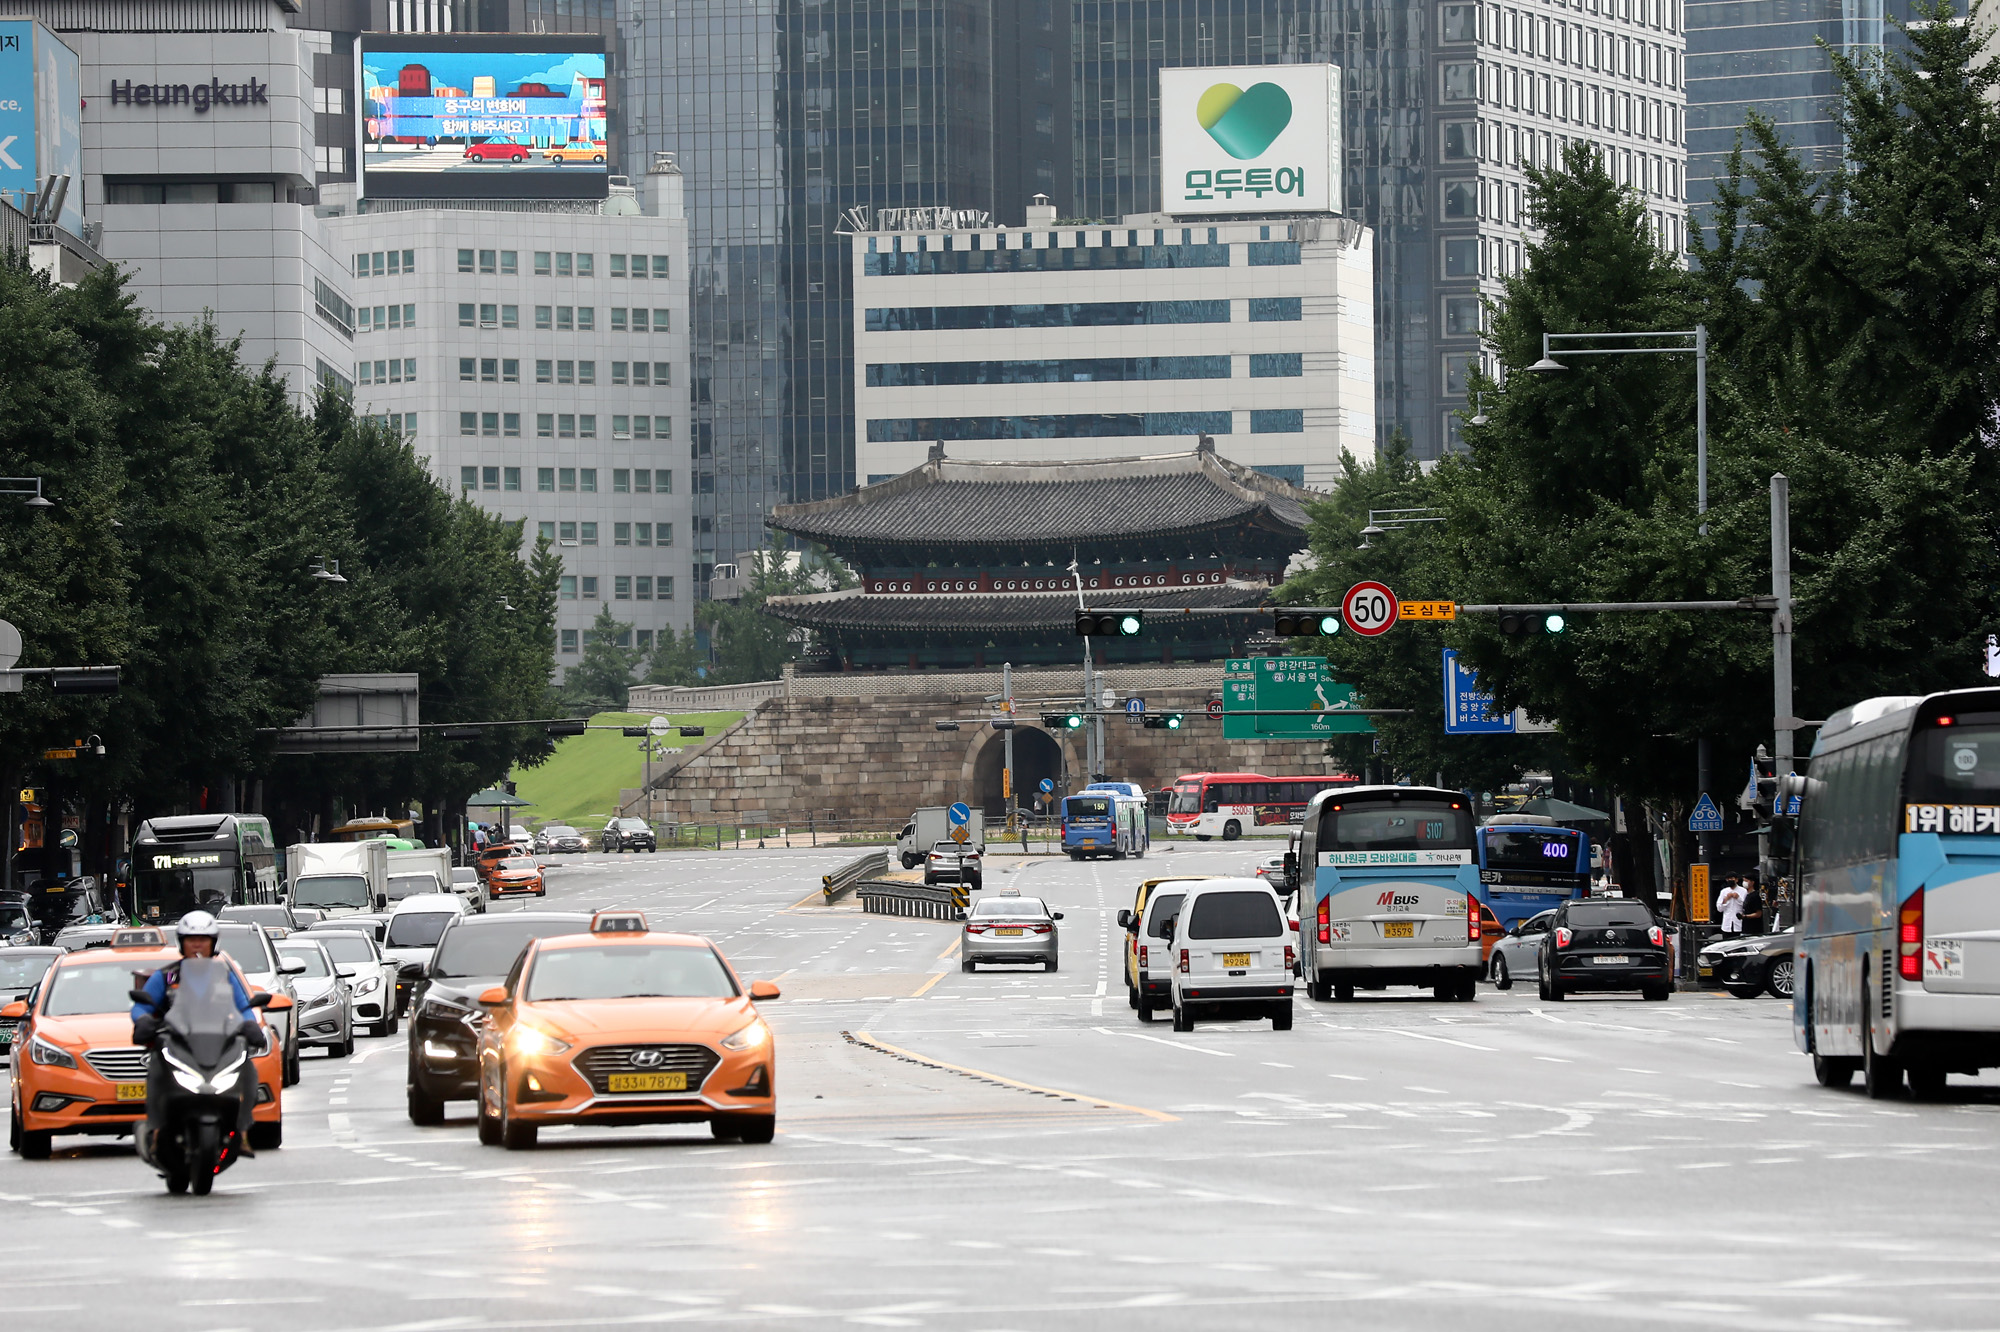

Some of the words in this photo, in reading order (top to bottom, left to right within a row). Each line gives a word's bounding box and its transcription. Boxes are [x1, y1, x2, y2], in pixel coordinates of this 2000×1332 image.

[0, 35, 19, 51] 지
[111, 76, 268, 113] Heungkuk
[445, 99, 485, 114] 중구의
[486, 99, 526, 114] 변화에
[441, 119, 469, 134] 함께
[1184, 166, 1304, 200] 모두투어
[1355, 595, 1386, 623] 50
[1402, 605, 1451, 616] 도심부
[1279, 660, 1317, 671] 한강대교
[1287, 672, 1318, 682] 서울역
[1692, 822, 1720, 830] 자전거횡단
[1908, 805, 1943, 833] 1위
[1949, 805, 2000, 833] 해커
[1543, 843, 1568, 858] 400
[153, 855, 172, 869] 1711
[1329, 853, 1368, 864] 하나원큐
[1370, 852, 1417, 864] 모바일대출
[1436, 853, 1462, 862] 하나은행
[606, 919, 635, 930] 서울
[1229, 957, 1250, 967] 9284
[648, 1075, 682, 1088] 7879
